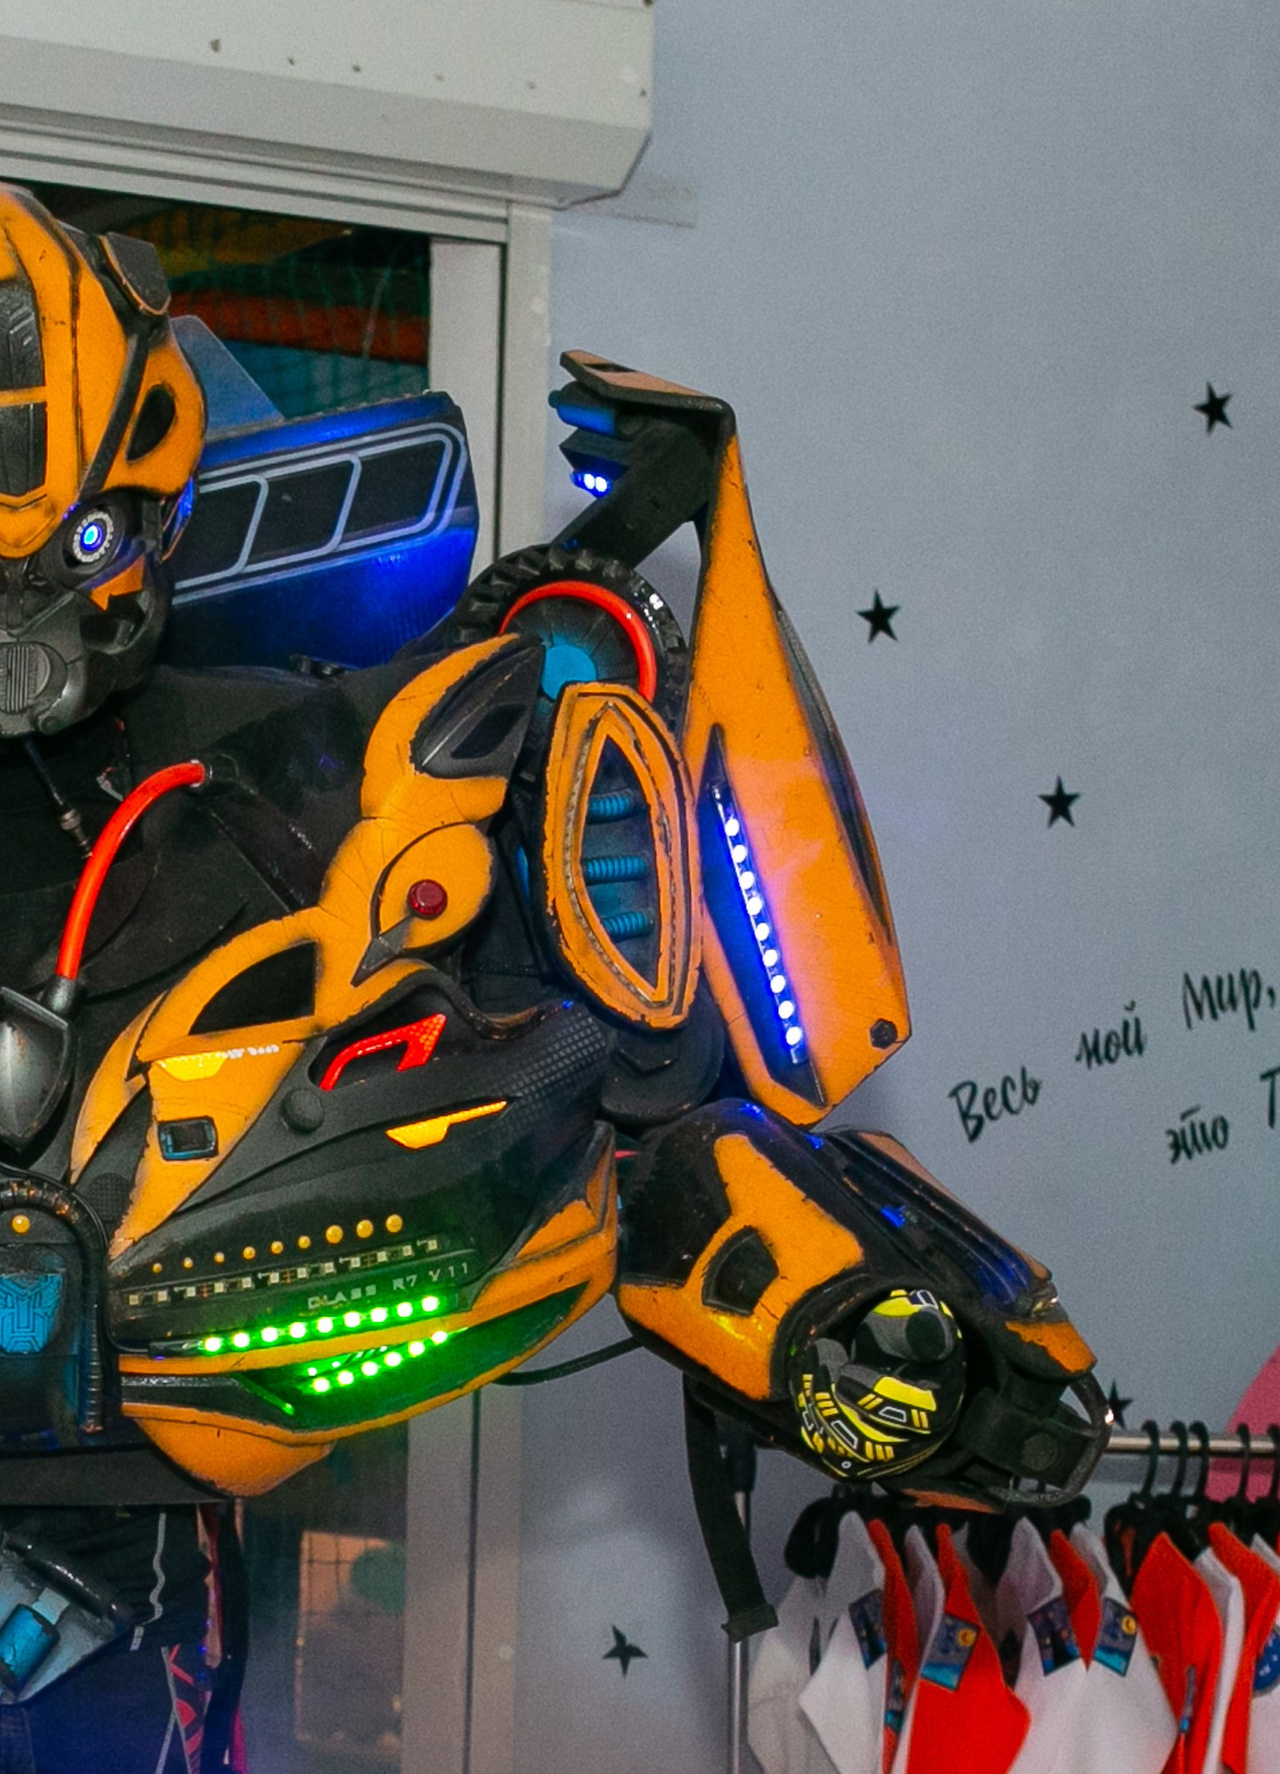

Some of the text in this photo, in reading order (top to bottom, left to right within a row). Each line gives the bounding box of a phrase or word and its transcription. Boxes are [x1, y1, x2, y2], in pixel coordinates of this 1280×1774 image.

[949, 968, 1276, 1143] Весь мой Мир,
[1165, 1105, 1229, 1164] это
